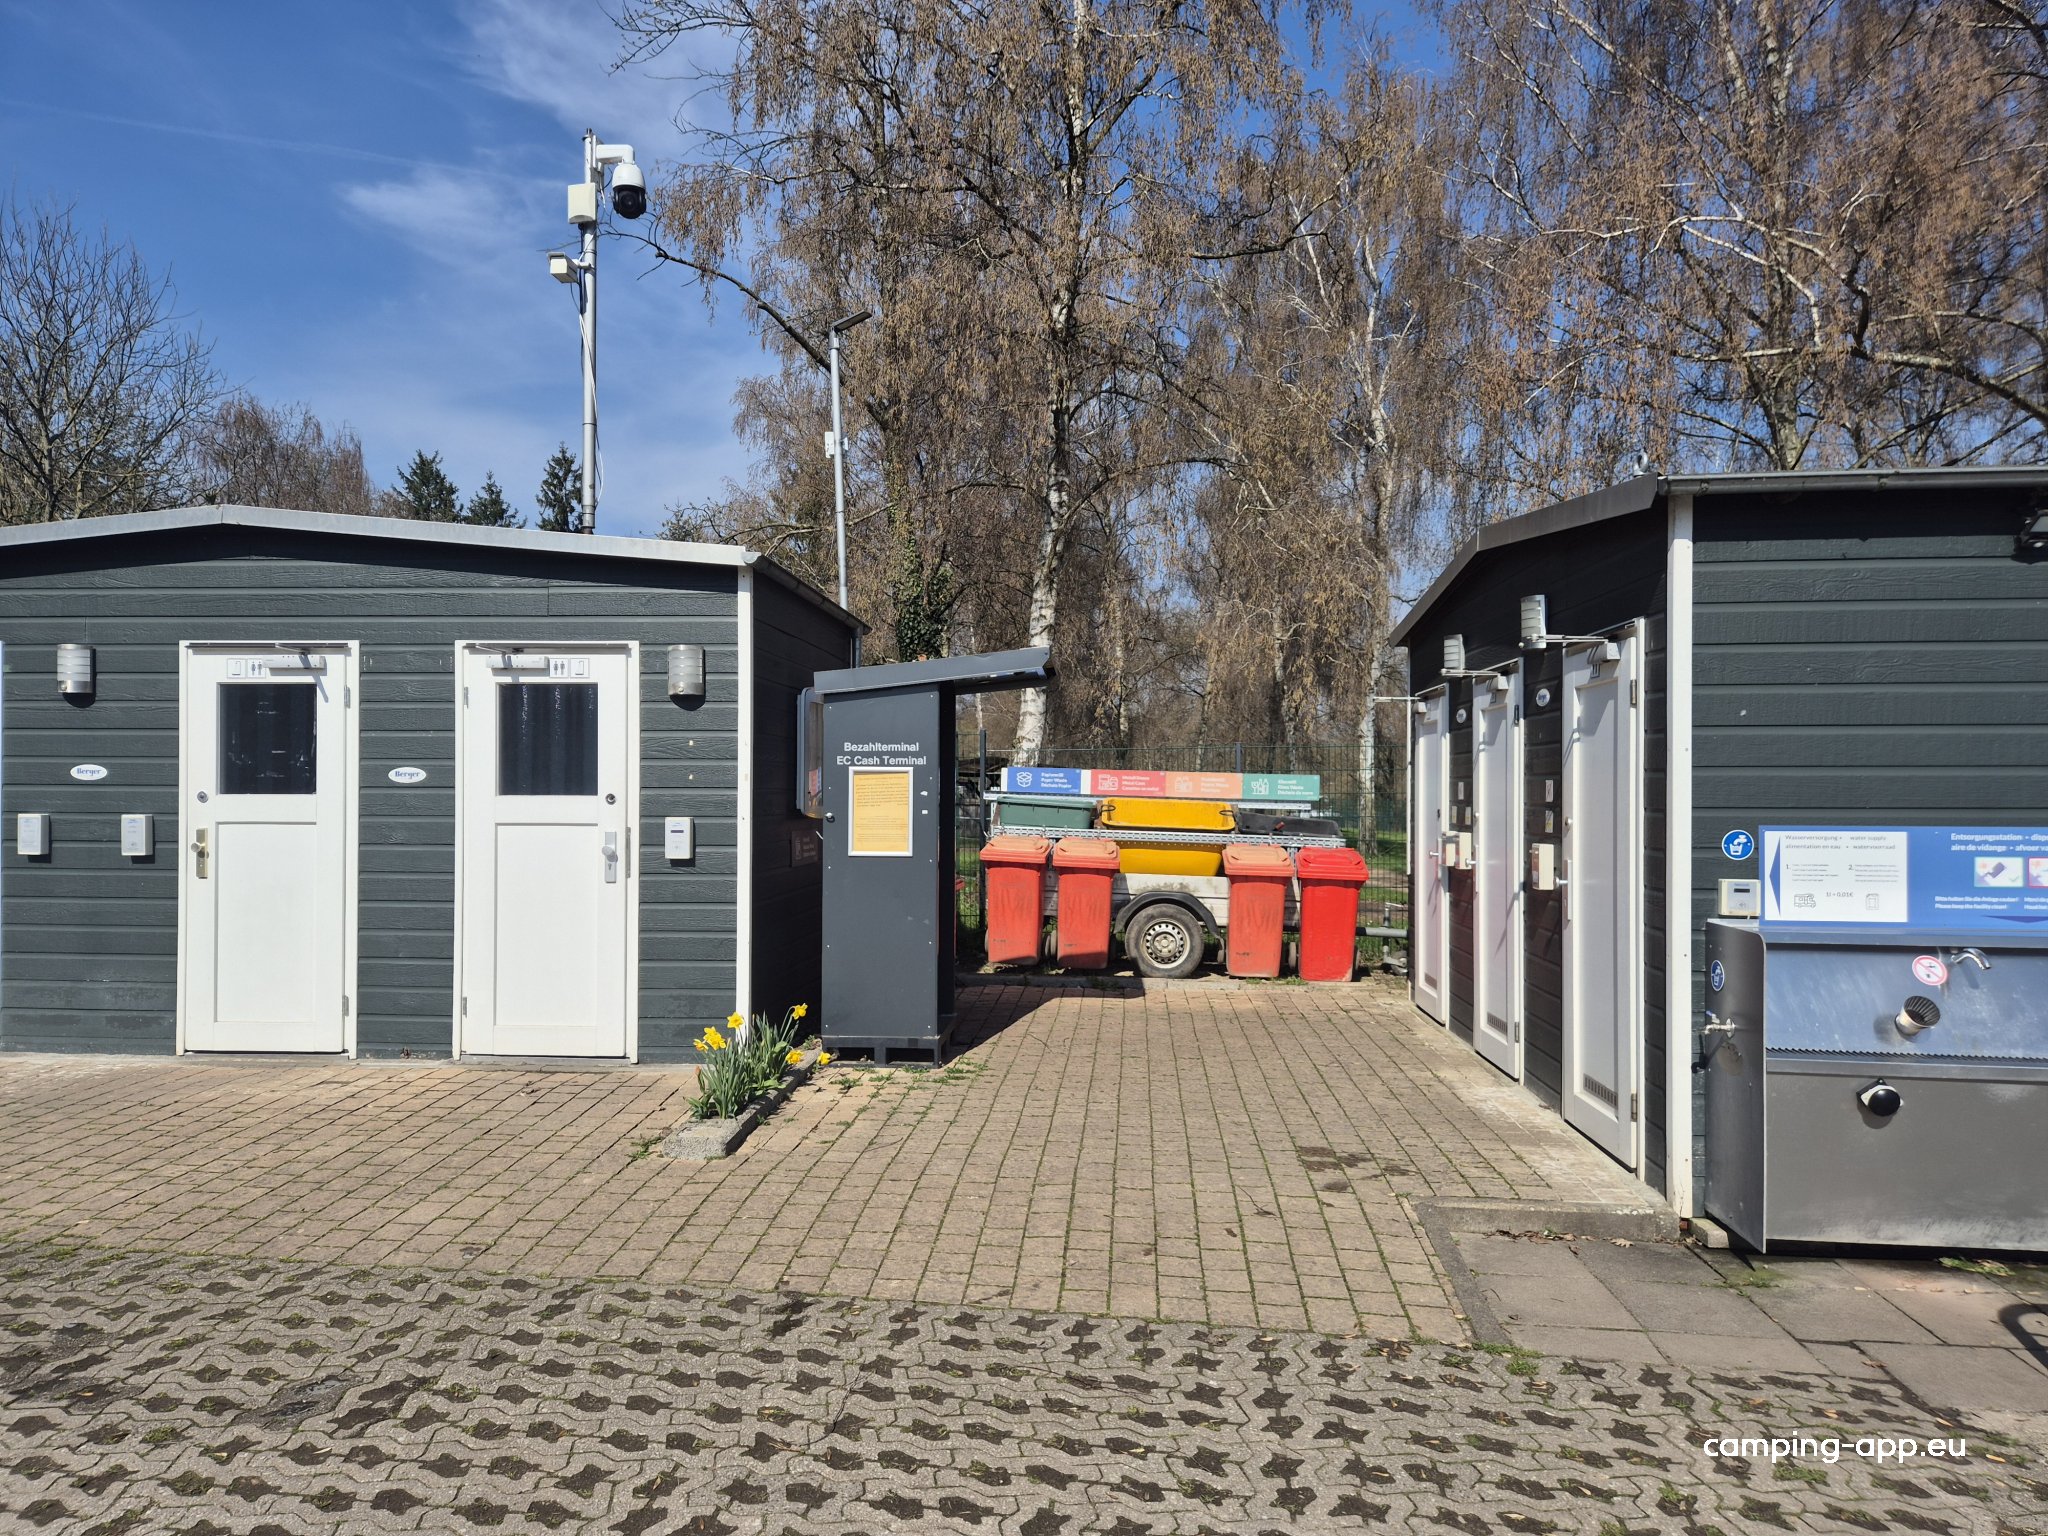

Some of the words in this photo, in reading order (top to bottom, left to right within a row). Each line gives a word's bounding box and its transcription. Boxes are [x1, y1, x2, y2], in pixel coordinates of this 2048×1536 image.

[843, 742, 919, 752] Bezahlterminal
[836, 756, 851, 765] EC
[854, 756, 880, 765] Cash
[882, 756, 926, 765] Terminal
[77, 767, 101, 776] Berger
[395, 770, 419, 780] Berger
